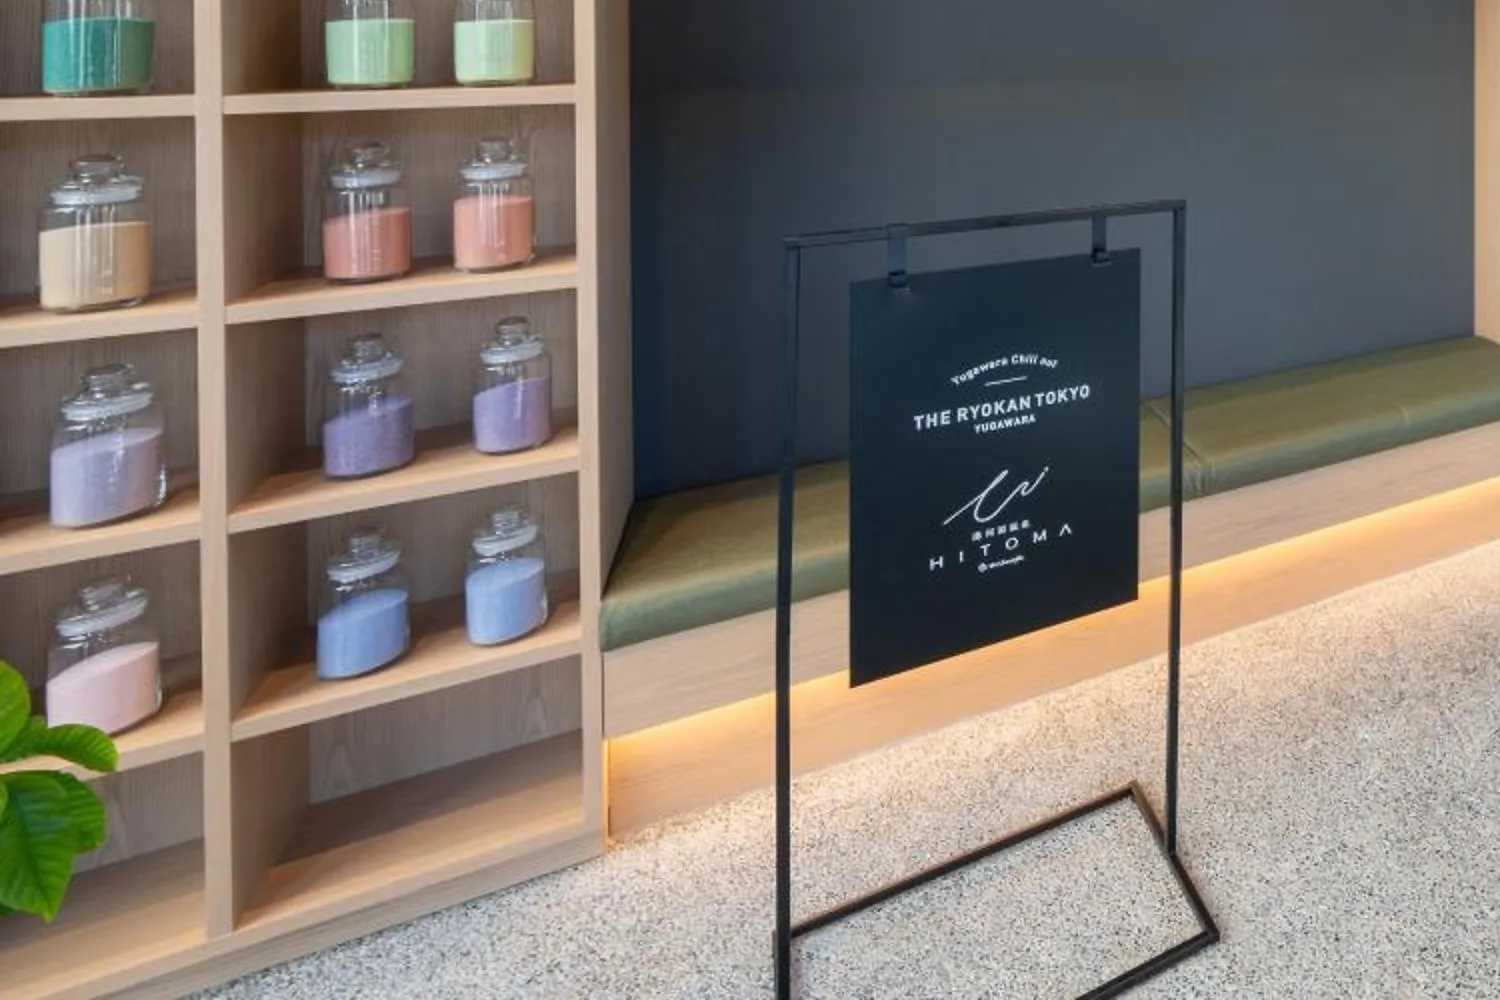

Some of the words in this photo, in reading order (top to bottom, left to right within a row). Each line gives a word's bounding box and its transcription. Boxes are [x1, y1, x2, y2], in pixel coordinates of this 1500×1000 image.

[951, 357, 1008, 385] Yugawara
[1011, 353, 1039, 365] Chill
[913, 410, 951, 431] THE
[957, 395, 1031, 423] RYOKAN
[1034, 384, 1091, 407] TOKYO
[974, 413, 1037, 434] YUGAWARA
